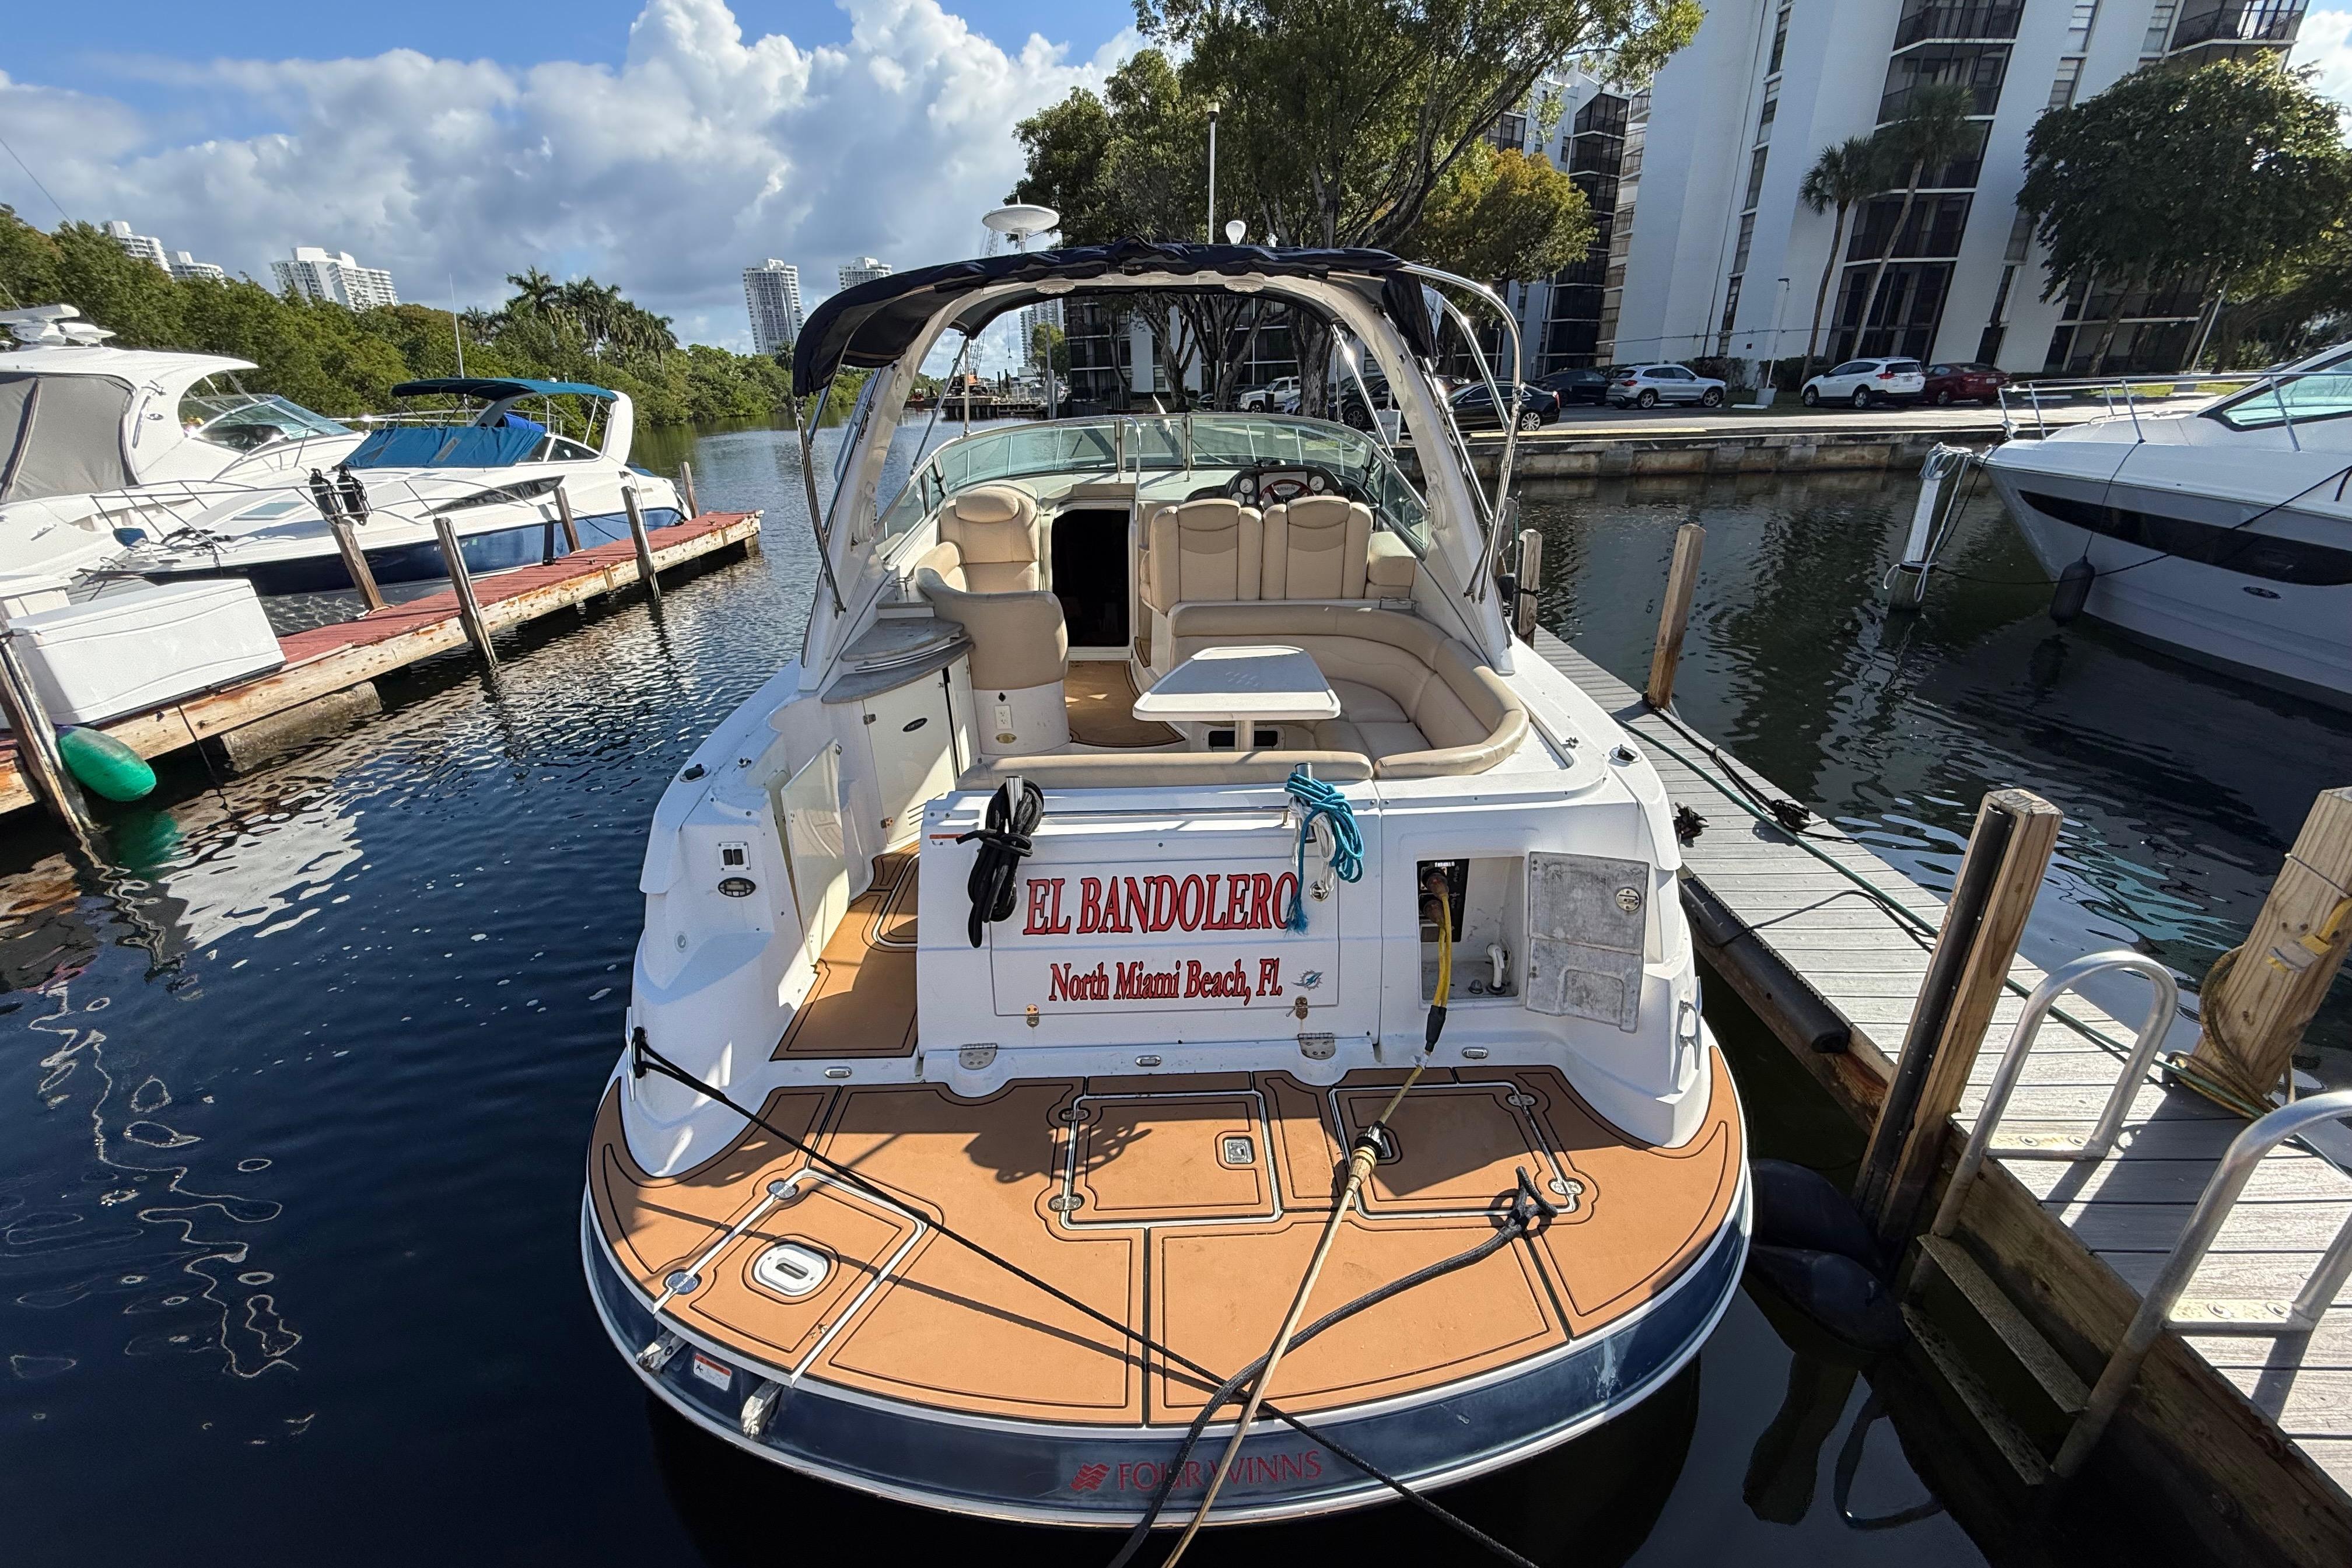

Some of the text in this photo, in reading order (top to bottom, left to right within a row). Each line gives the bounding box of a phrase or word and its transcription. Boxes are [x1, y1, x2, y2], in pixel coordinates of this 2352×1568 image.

[1023, 872, 1298, 935] EL BANDOLERO
[1049, 962, 1109, 1001] North
[1114, 960, 1180, 999] Miami
[1184, 958, 1251, 1006] Beach,
[1209, 1450, 1322, 1485] WINNS
